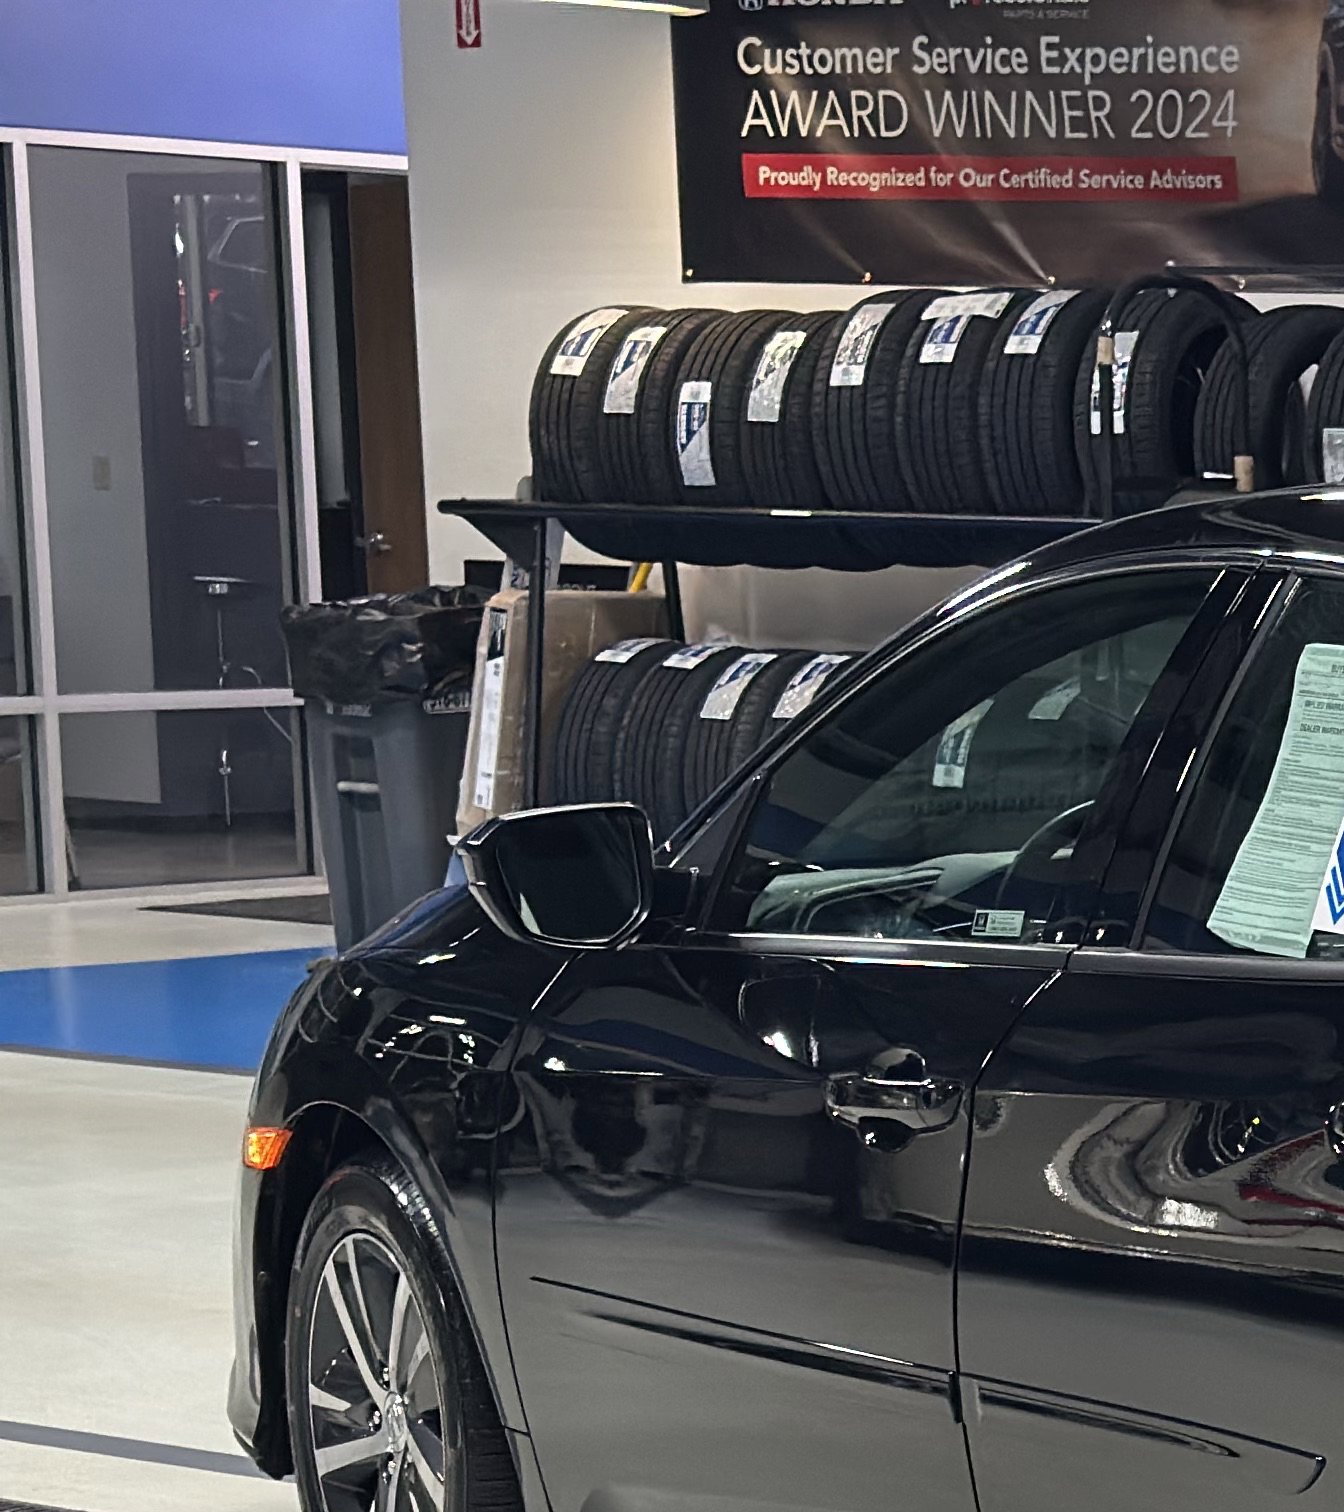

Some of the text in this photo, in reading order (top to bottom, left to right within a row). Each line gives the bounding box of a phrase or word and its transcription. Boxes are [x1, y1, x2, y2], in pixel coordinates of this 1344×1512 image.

[736, 35, 1240, 86] Customer Service Experience
[740, 88, 1239, 139] AWARD WINNER 2024
[758, 165, 1223, 191] Proudly Recognized for Our Certified Service Advisors
